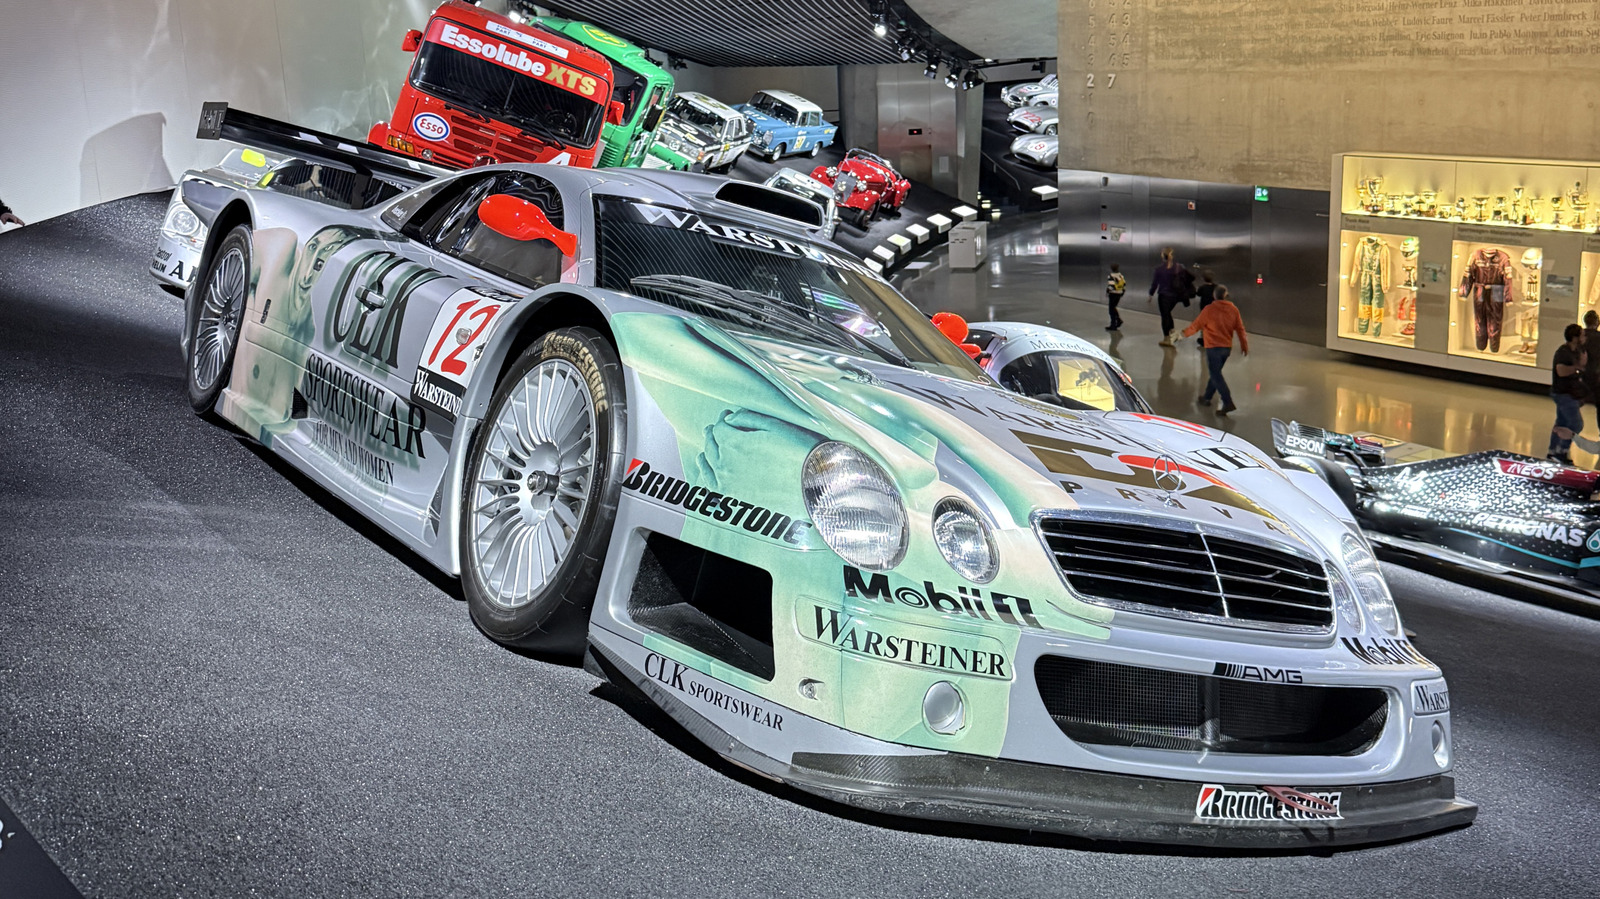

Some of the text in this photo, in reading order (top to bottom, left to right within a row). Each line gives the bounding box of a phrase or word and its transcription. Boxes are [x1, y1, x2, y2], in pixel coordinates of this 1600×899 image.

[1458, 14, 1484, 24] Marcel
[440, 23, 598, 96] Essolube XTS
[1086, 73, 1117, 89] 2 7
[419, 118, 444, 135] Esso
[333, 250, 459, 369] CLK
[428, 299, 501, 376] 12
[305, 353, 427, 460] SPORTSWEAR
[1285, 434, 1325, 454] EPSON
[359, 446, 395, 487] WOMEN
[1507, 463, 1558, 481] INEOS
[621, 457, 813, 545] BRIDGESTONE
[1472, 511, 1585, 548] PETRONAS
[843, 564, 994, 622] Mobil
[813, 604, 1007, 677] WARSTEINER
[644, 652, 784, 732] CLK SPORTSWEAR
[1241, 665, 1304, 684] AMG
[1415, 684, 1449, 711] WARST
